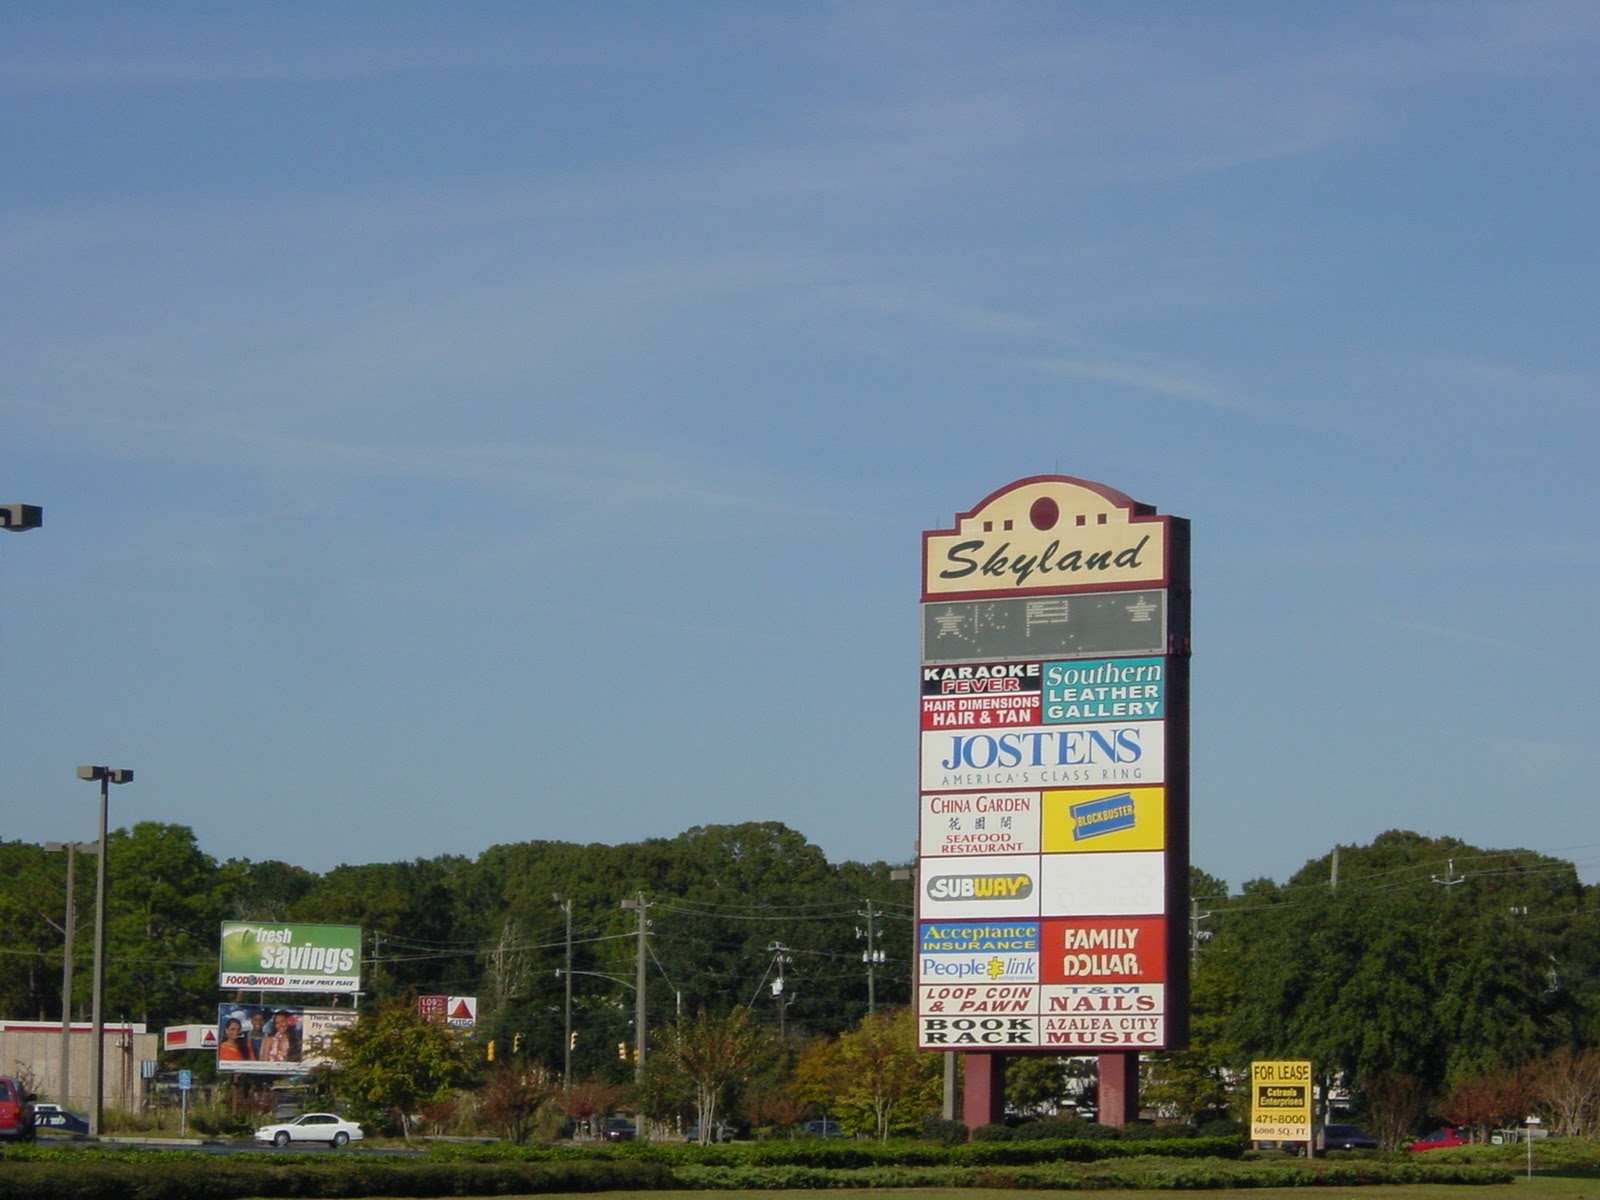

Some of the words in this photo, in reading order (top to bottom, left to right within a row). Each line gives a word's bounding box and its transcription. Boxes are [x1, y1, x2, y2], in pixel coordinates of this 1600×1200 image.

[939, 535, 1150, 586] Skyland
[923, 664, 1040, 681] KARAOKE
[1046, 662, 1162, 686] Southern
[942, 678, 1020, 693] FEVER
[1049, 685, 1159, 702] LEATHER
[924, 700, 955, 712] HAIR
[958, 696, 1040, 709] DIMENSIONS
[1047, 701, 1160, 719] GALLERY
[932, 711, 975, 726] HAIR
[979, 710, 992, 724] &
[996, 708, 1031, 723] TAN
[941, 728, 1143, 770] JOSTENS
[942, 773, 1030, 786] AMERICA'S
[1041, 770, 1090, 781] CLASS
[1102, 768, 1143, 780] RING
[1077, 804, 1134, 827] BLOCKBUSTER
[946, 833, 1012, 844] SEAFOOD
[941, 842, 1024, 854] RESTAURANT
[930, 876, 1030, 899] SUBWAY
[256, 928, 292, 944] fresh
[924, 926, 1037, 941] Acceptance
[1064, 928, 1139, 950] FAMILY
[923, 941, 1036, 950] INSURANCE
[260, 943, 354, 974] savings
[922, 958, 986, 979] People
[1005, 957, 1036, 975] link
[226, 975, 248, 985] FOOD
[255, 975, 285, 985] WORLD
[926, 988, 978, 999] LOOP
[986, 987, 1033, 998] COIN
[1065, 986, 1140, 994] T&M
[928, 1001, 945, 1012] &
[959, 1000, 1030, 1012] PAWN
[1049, 995, 1156, 1012] NAILS
[924, 1018, 1033, 1031] BOOK
[1045, 1018, 1113, 1030] AZALEA
[1119, 1018, 1159, 1030] CITY
[924, 1032, 1033, 1044] RACK
[1046, 1031, 1158, 1044] MUSIC
[1254, 1066, 1274, 1079] FOR
[1278, 1066, 1309, 1079] LEASE
[1260, 1097, 1303, 1106] Enterprises
[1256, 1115, 1306, 1124] 471-8000
